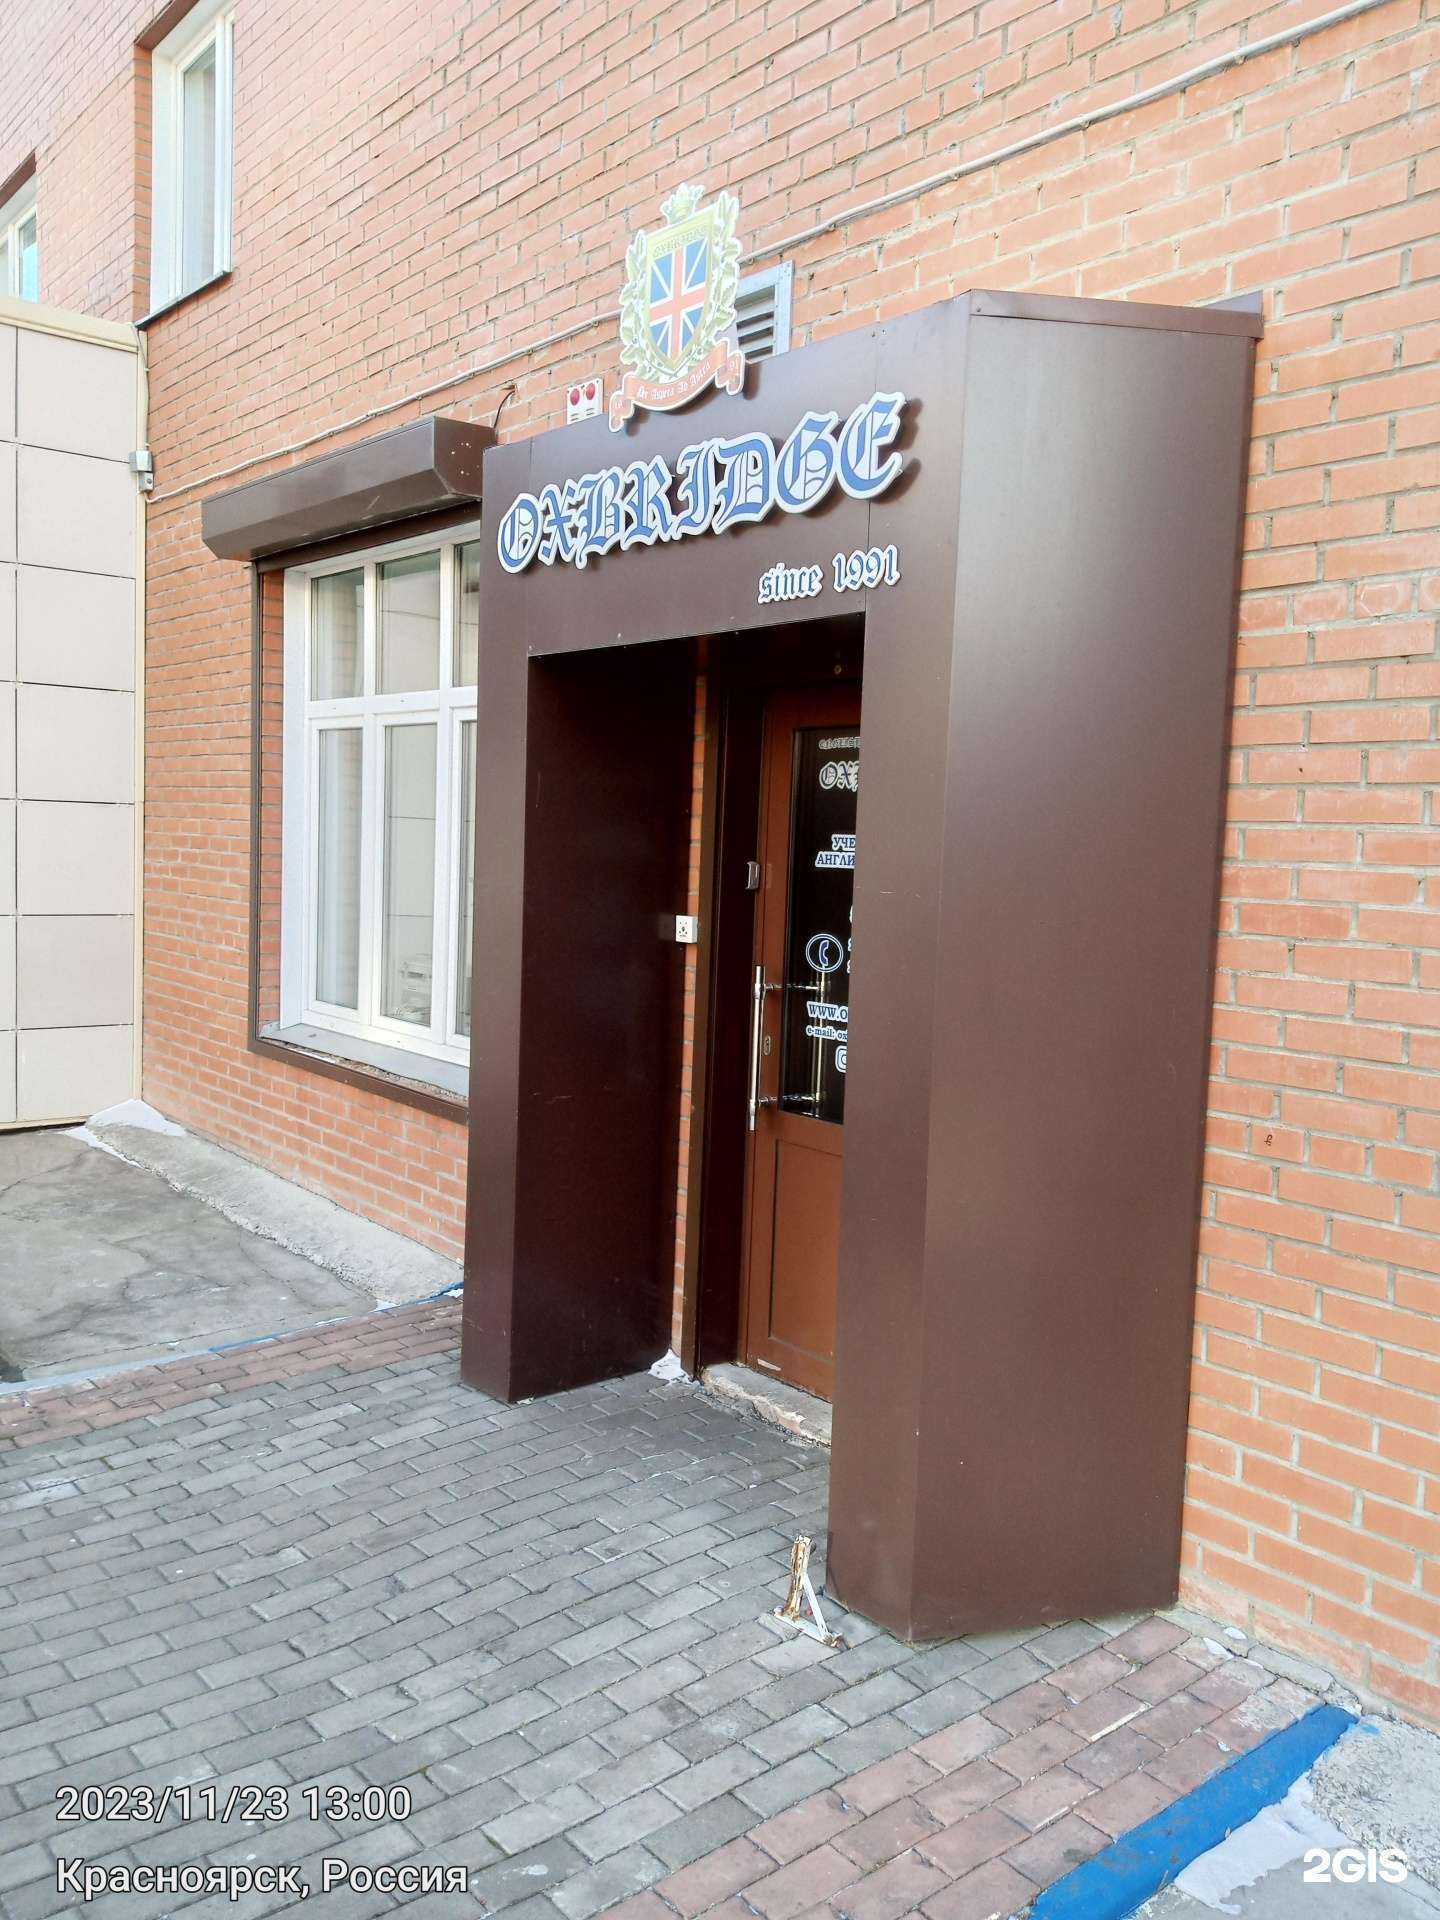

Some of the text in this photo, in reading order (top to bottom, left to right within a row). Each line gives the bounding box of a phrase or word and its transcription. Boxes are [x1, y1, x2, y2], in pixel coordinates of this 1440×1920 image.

[497, 391, 905, 574] OXBRIDGE
[758, 544, 901, 604] since 1991
